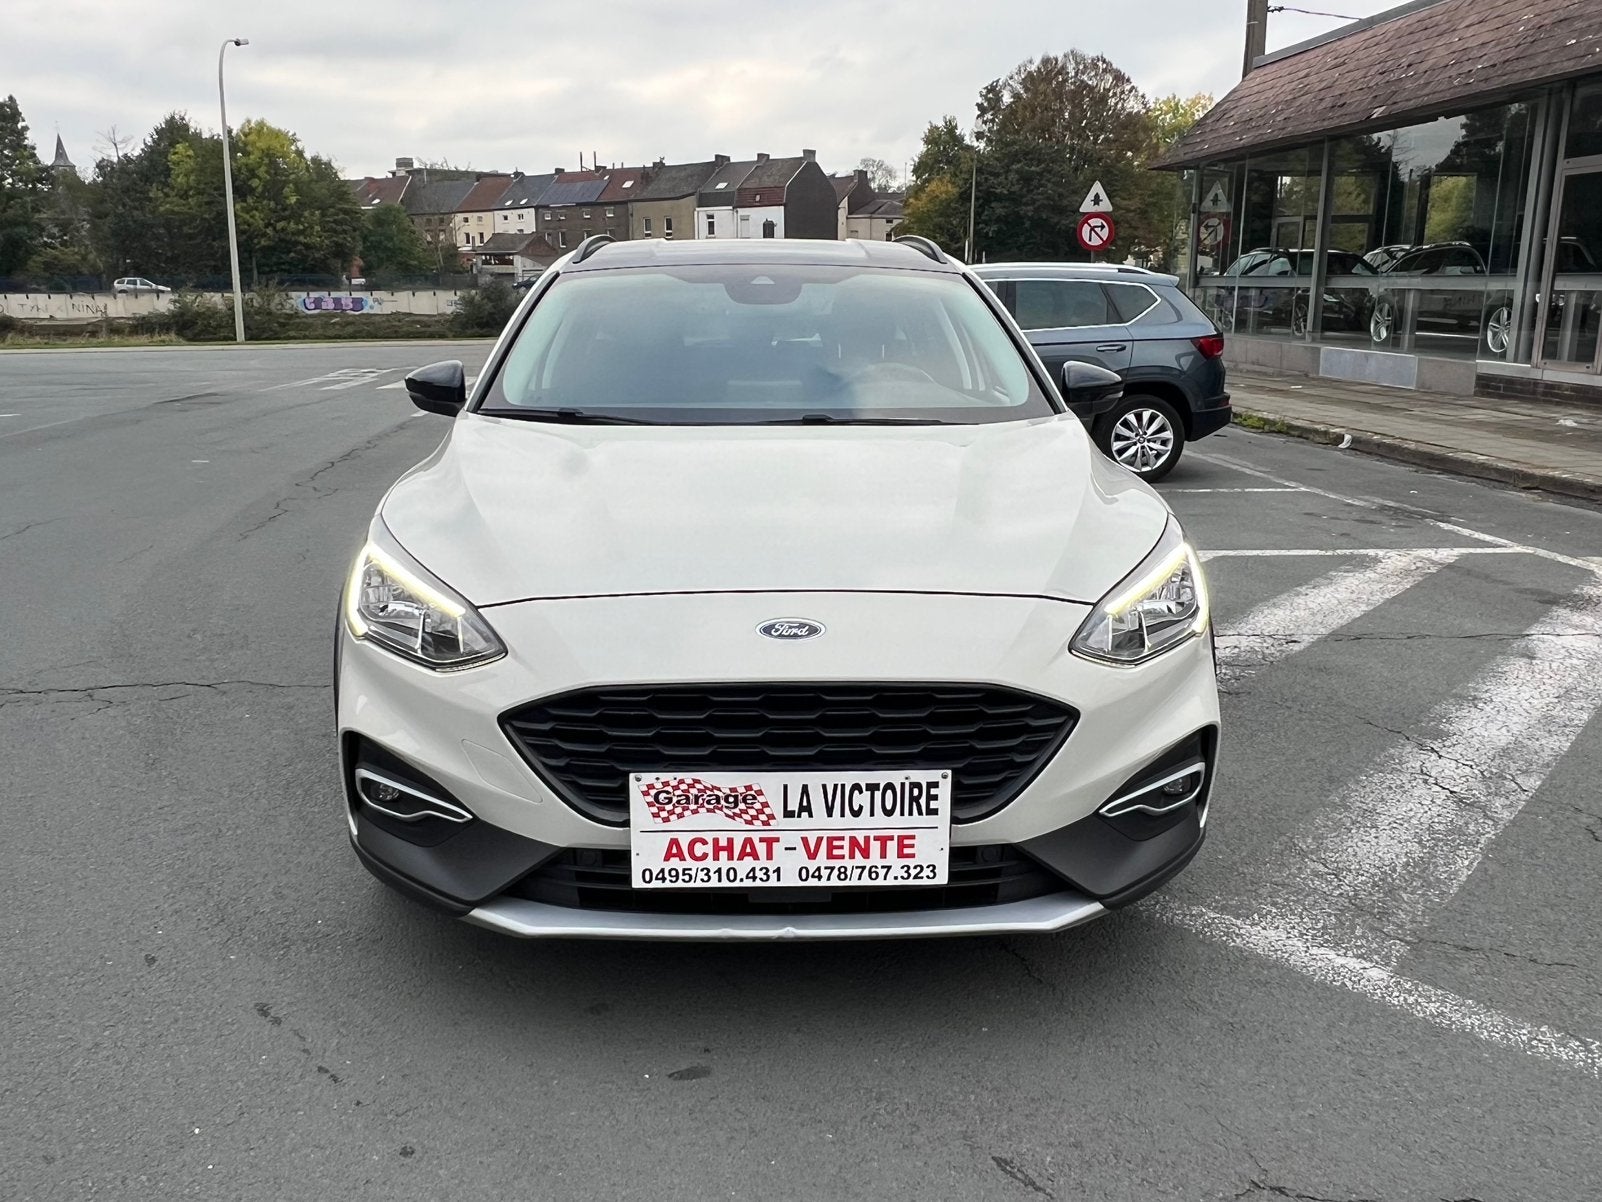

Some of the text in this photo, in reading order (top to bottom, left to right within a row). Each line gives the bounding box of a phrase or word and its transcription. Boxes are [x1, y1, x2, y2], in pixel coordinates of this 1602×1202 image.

[771, 622, 809, 636] Ford
[653, 781, 939, 818] Garage LA VICTOIRE
[641, 864, 937, 884] 0495/310.431 0478/767.323
